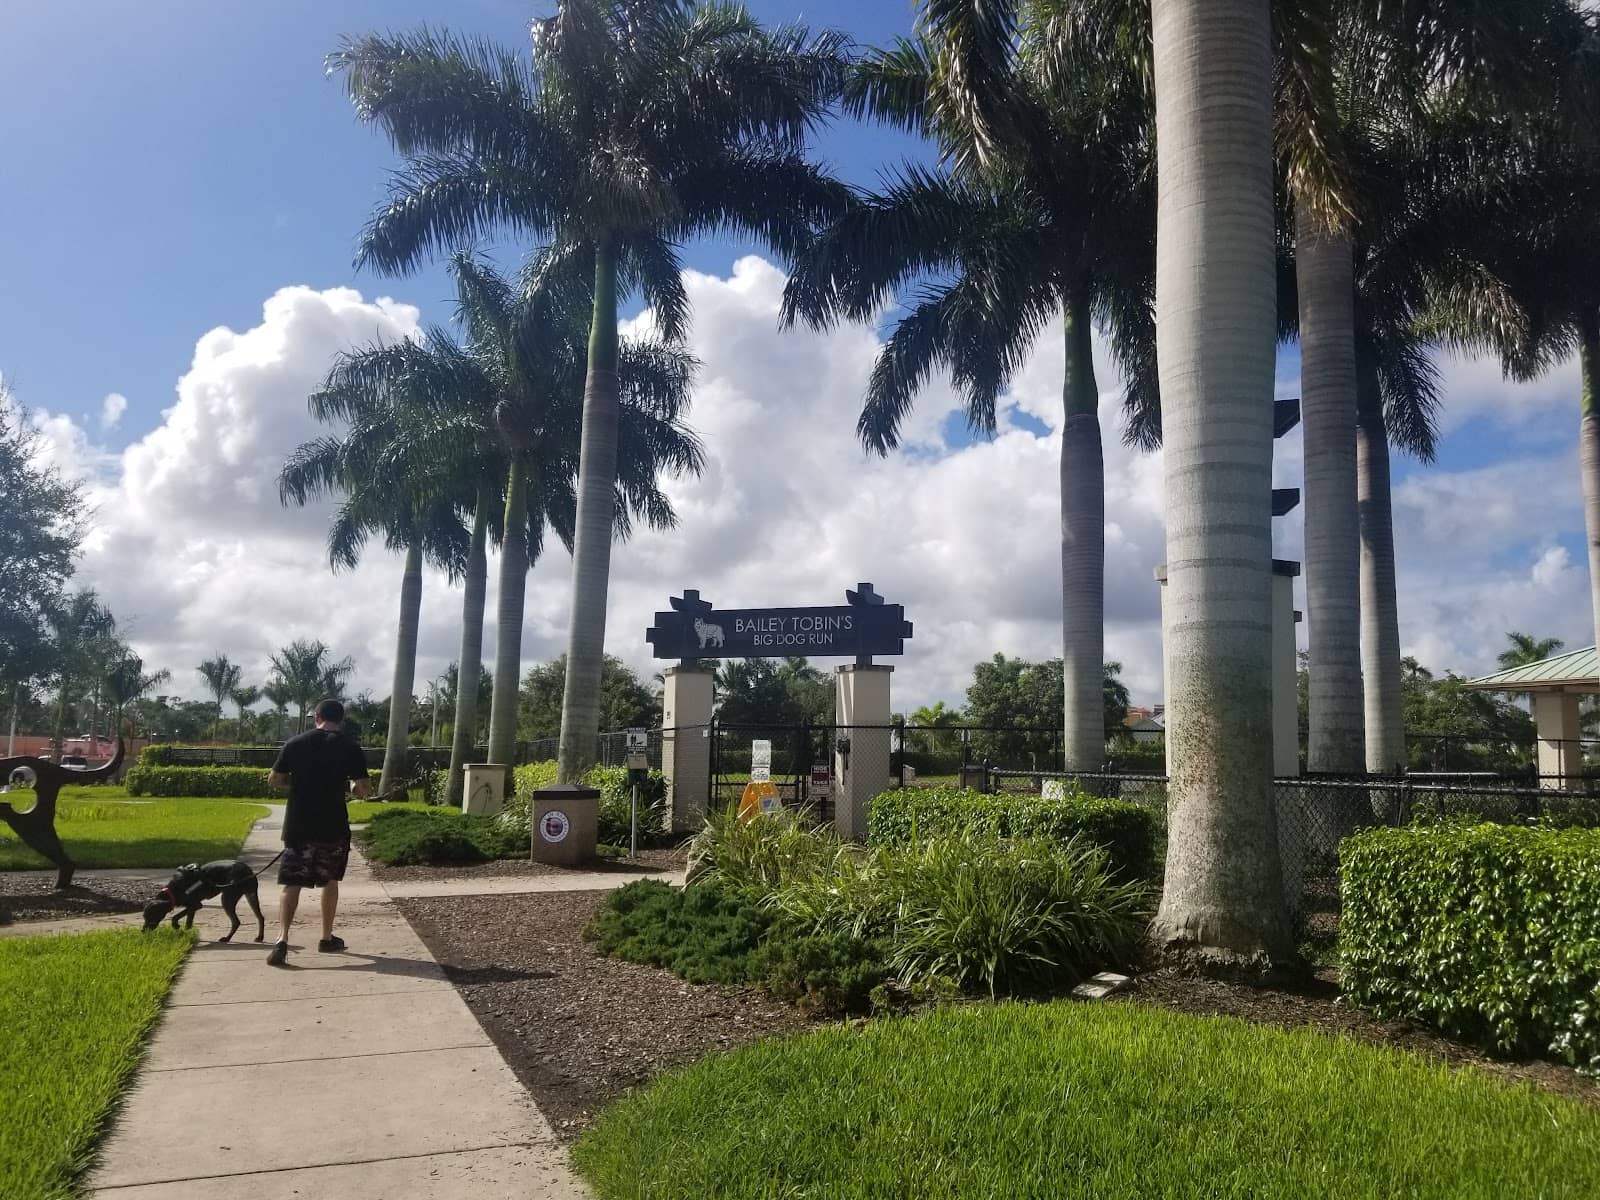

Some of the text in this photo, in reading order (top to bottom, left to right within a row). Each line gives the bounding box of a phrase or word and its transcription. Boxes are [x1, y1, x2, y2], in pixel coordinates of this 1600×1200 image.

[735, 615, 853, 632] BAILEY TOBIN'S
[753, 633, 833, 646] BIG DOG RUN
